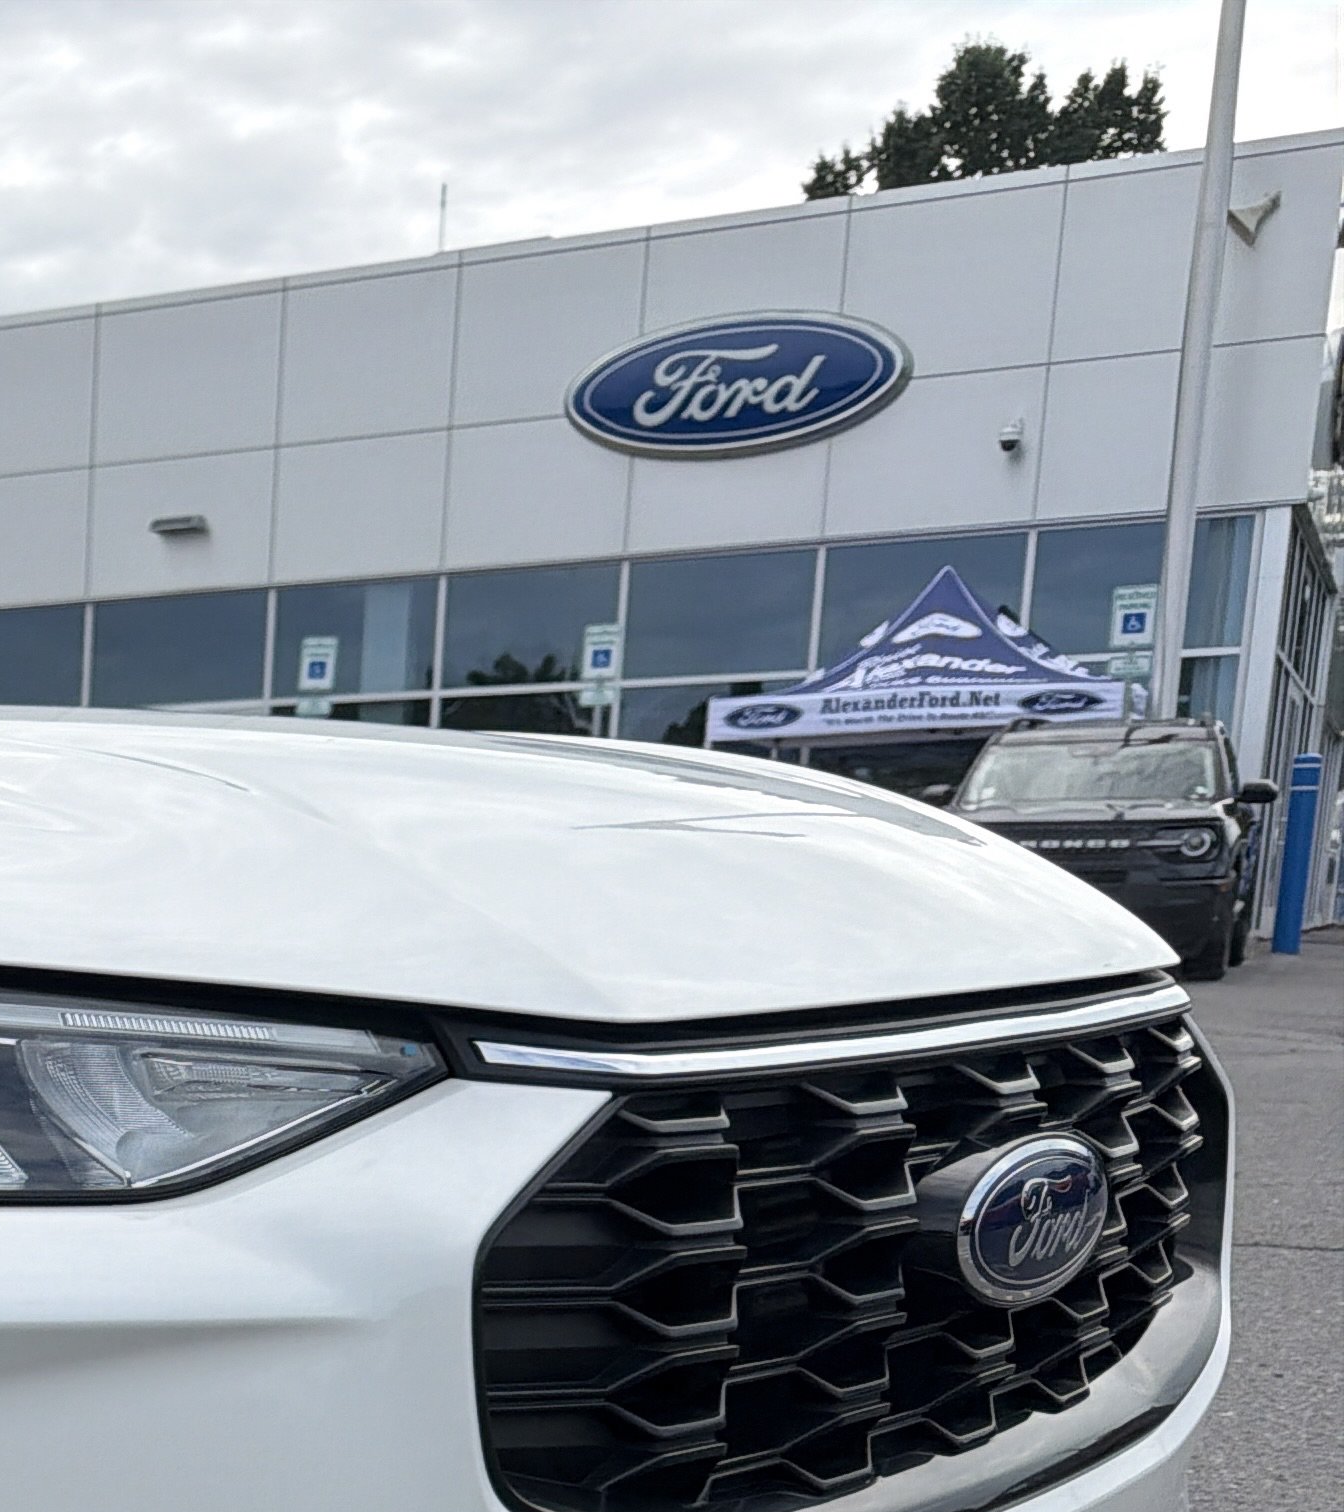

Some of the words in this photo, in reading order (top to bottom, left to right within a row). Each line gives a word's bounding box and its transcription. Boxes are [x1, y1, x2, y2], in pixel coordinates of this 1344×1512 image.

[633, 343, 826, 428] Ford
[820, 690, 1002, 714] AlexanderFord.Net
[1020, 839, 1130, 849] RONCO
[1008, 1174, 1100, 1268] Ford
